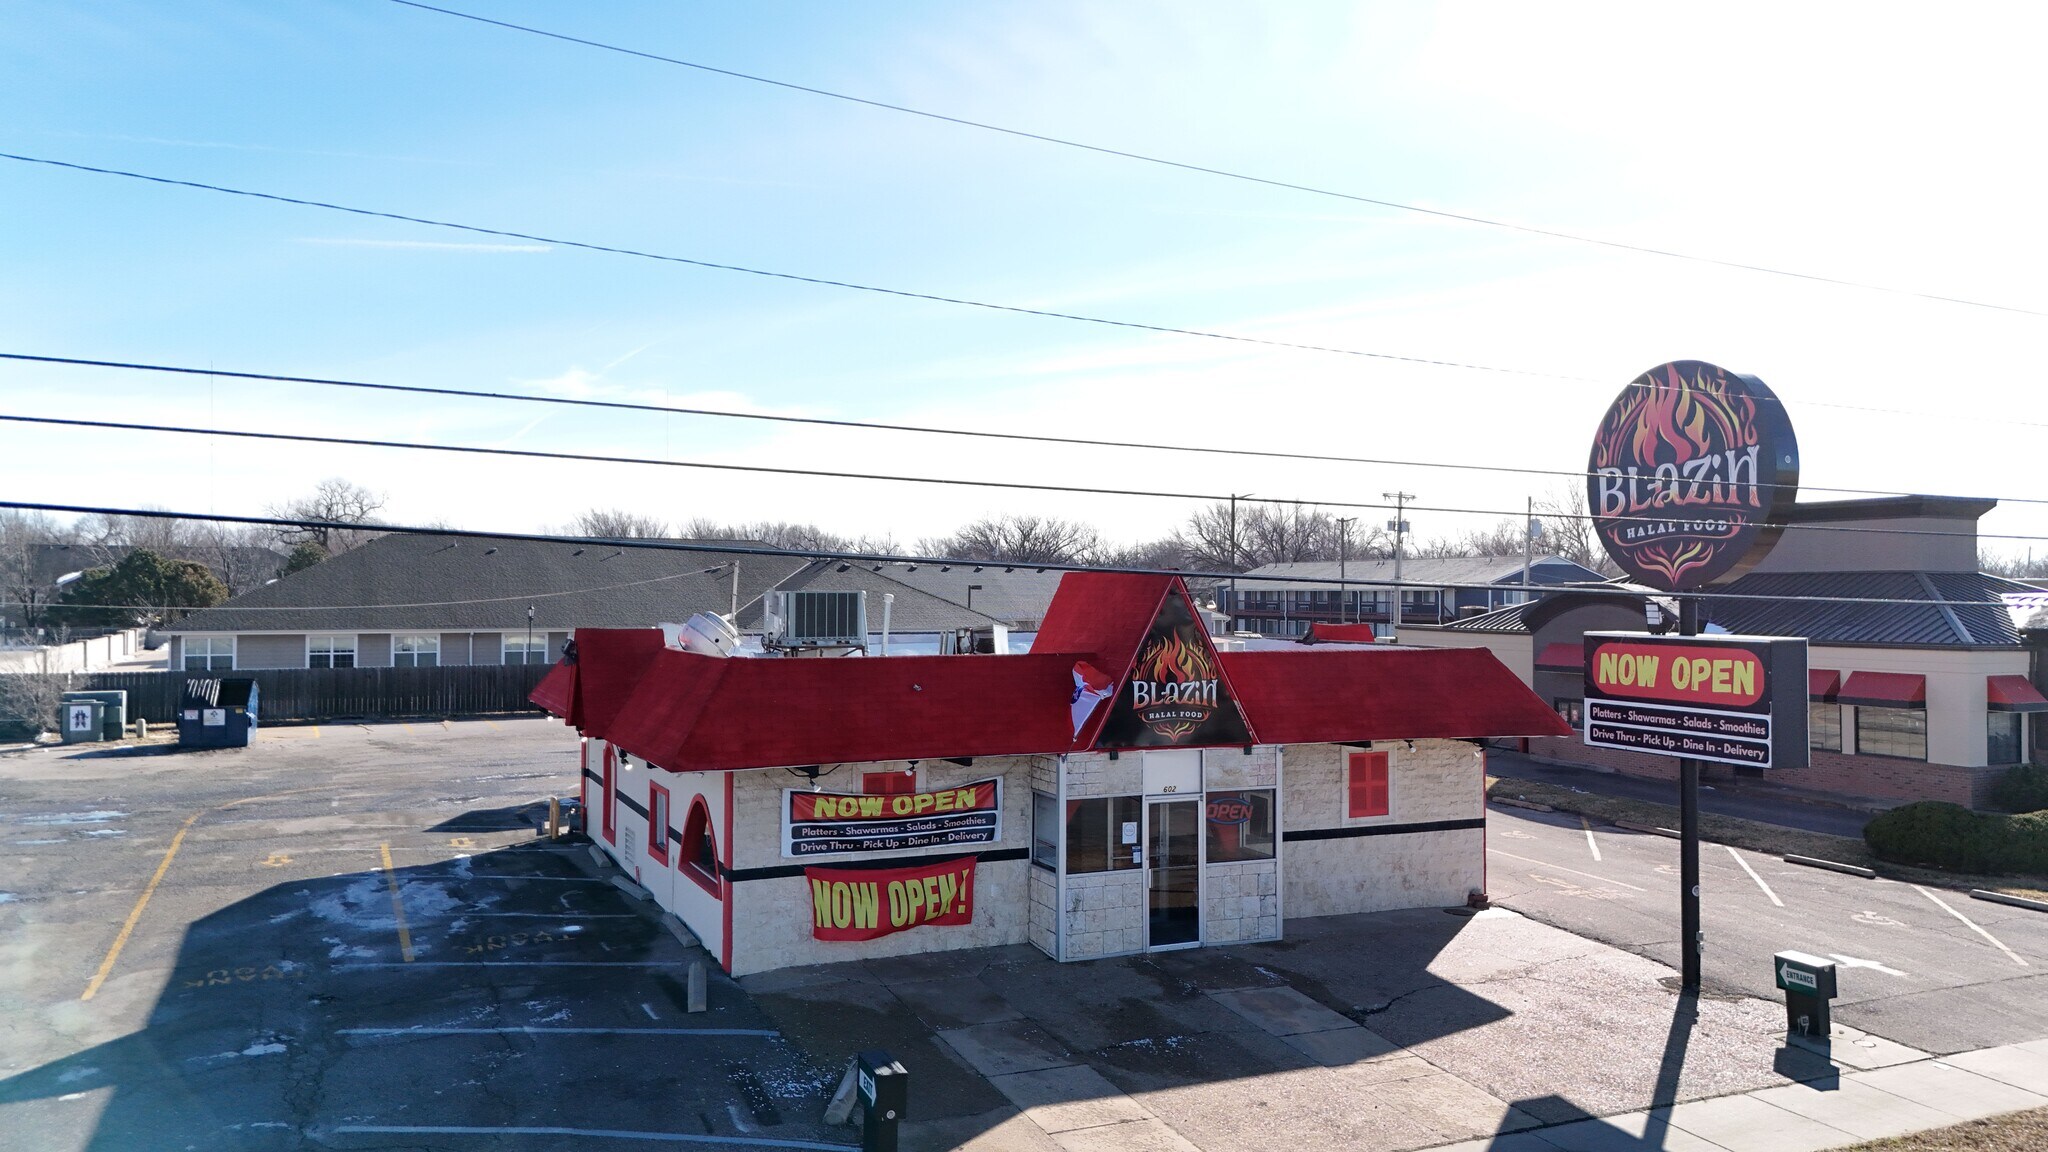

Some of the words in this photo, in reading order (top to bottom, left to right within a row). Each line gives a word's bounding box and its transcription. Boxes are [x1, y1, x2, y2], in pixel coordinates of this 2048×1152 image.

[1626, 521, 1676, 539] HALAL
[1683, 519, 1728, 532] FOOD
[1599, 652, 1659, 688] NOW
[1671, 656, 1755, 696] OPEN
[1149, 711, 1177, 719] HALAL
[1180, 711, 1203, 719] FOOD
[1592, 707, 1622, 720] Platters
[1628, 710, 1676, 726] Shawarmas
[1683, 716, 1712, 730] Salads
[1719, 720, 1766, 735] Smoothies
[1592, 728, 1615, 740] Drive
[1616, 730, 1636, 743] Thru
[1642, 734, 1661, 746] Pick
[1662, 735, 1675, 749] Up
[1683, 738, 1704, 752] Dine
[1706, 741, 1716, 752] In
[1723, 743, 1765, 761] Delivery
[814, 796, 885, 818] NOW
[892, 788, 977, 815] OPEN
[1206, 803, 1253, 819] OPEN
[801, 827, 837, 837] Platters
[845, 825, 899, 835] Shawarmas
[906, 821, 937, 832] Salads
[943, 816, 986, 828] Smoothies
[800, 842, 828, 852] Drive
[829, 841, 854, 850] Thru
[863, 840, 883, 849] Pick
[885, 840, 900, 850] Up
[908, 836, 929, 846] Dine
[931, 835, 940, 844] In
[948, 831, 988, 841] Delivery
[812, 878, 879, 929] NOW
[888, 868, 970, 928] OPEN!
[1786, 970, 1814, 985] ENTRANCE
